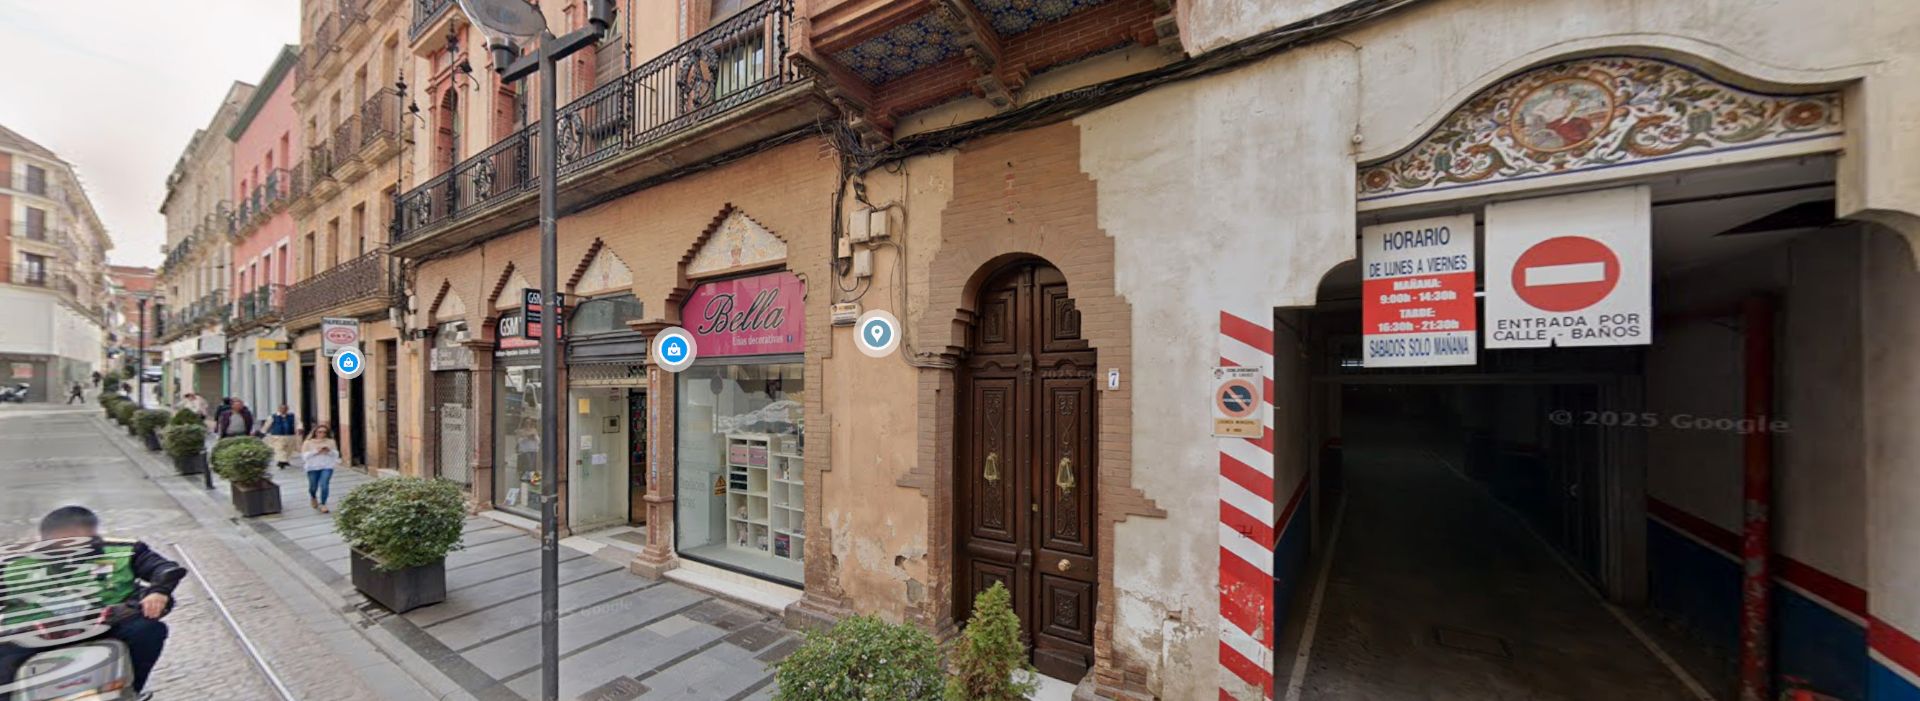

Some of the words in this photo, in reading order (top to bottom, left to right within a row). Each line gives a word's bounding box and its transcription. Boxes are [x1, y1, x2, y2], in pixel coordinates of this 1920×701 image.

[1383, 226, 1451, 250] HORARIO
[1369, 263, 1381, 277] DE
[1384, 259, 1413, 276] LUNES
[1417, 259, 1424, 273] A
[1427, 254, 1468, 272] VIERNES
[1393, 278, 1442, 291] MAÑANA:
[1380, 293, 1411, 304] 9:00h
[1418, 291, 1457, 302] 14:30h
[697, 287, 784, 335] Bella
[1399, 308, 1436, 319] TARDE:
[500, 316, 518, 337] GSM
[1378, 322, 1414, 333] 16:30h
[1421, 319, 1460, 331] 21:30h
[1498, 316, 1587, 330] ENTRADA
[1599, 313, 1640, 325] POR
[1493, 330, 1547, 341] CALLE
[1571, 325, 1640, 339] BAÑOS
[1369, 338, 1406, 358] SABADOS
[1409, 337, 1431, 357] SOLO
[1434, 332, 1469, 355] MAÑANA
[1111, 372, 1117, 387] 7
